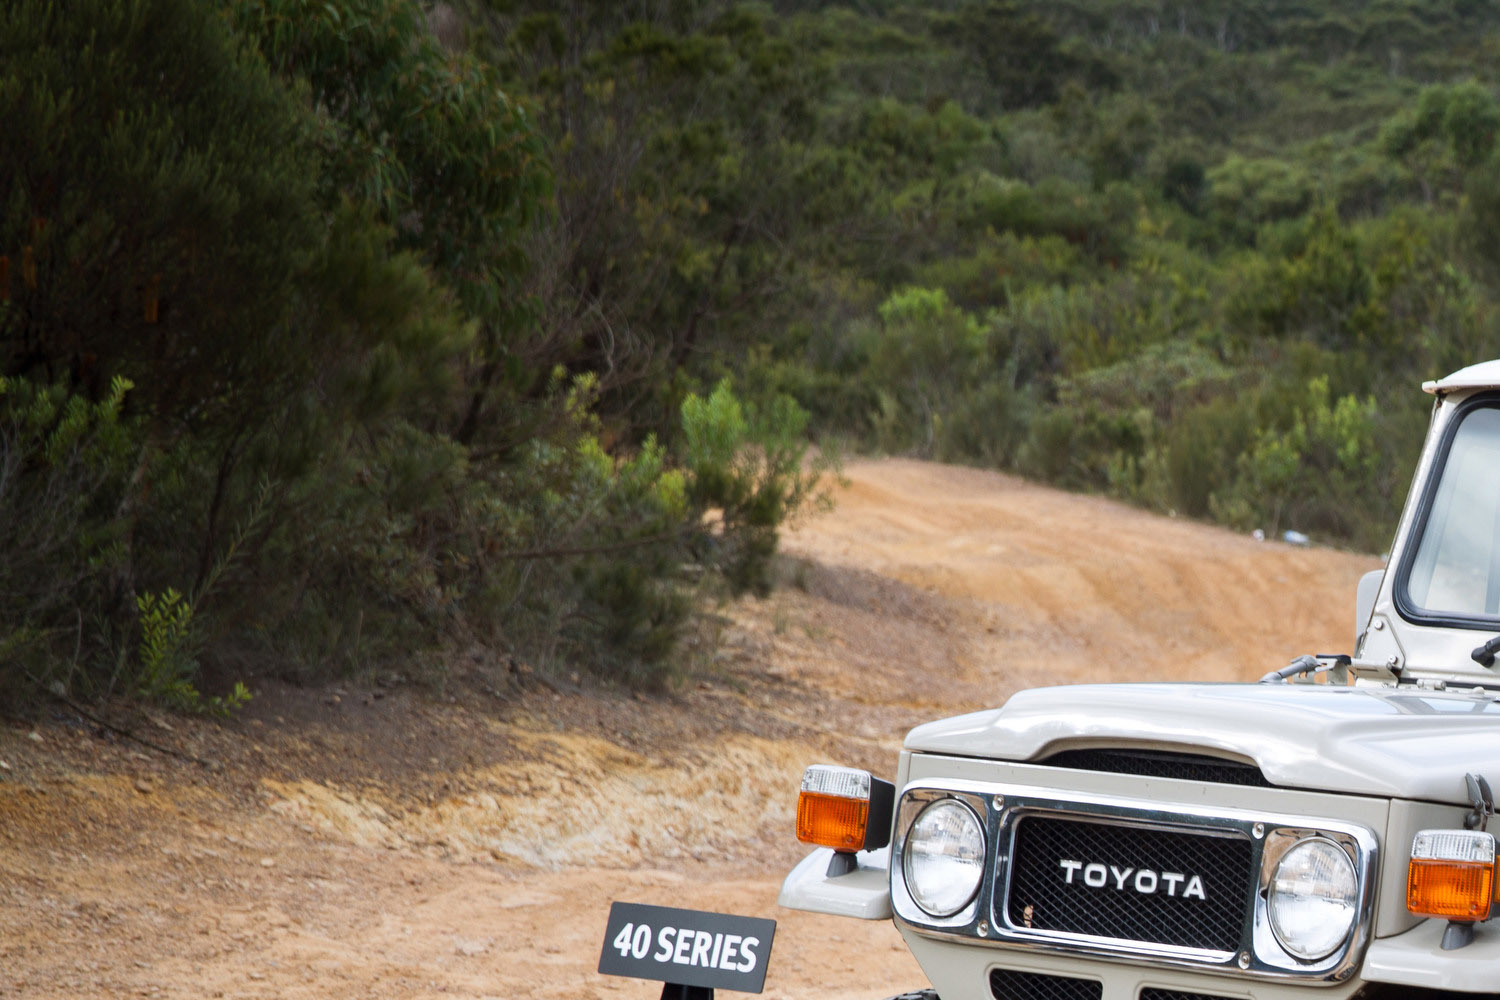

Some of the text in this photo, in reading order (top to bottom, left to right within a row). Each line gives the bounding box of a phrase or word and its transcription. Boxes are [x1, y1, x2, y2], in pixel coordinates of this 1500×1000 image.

[1060, 859, 1206, 900] TOYOTA
[613, 922, 760, 973] 40 SERIES
